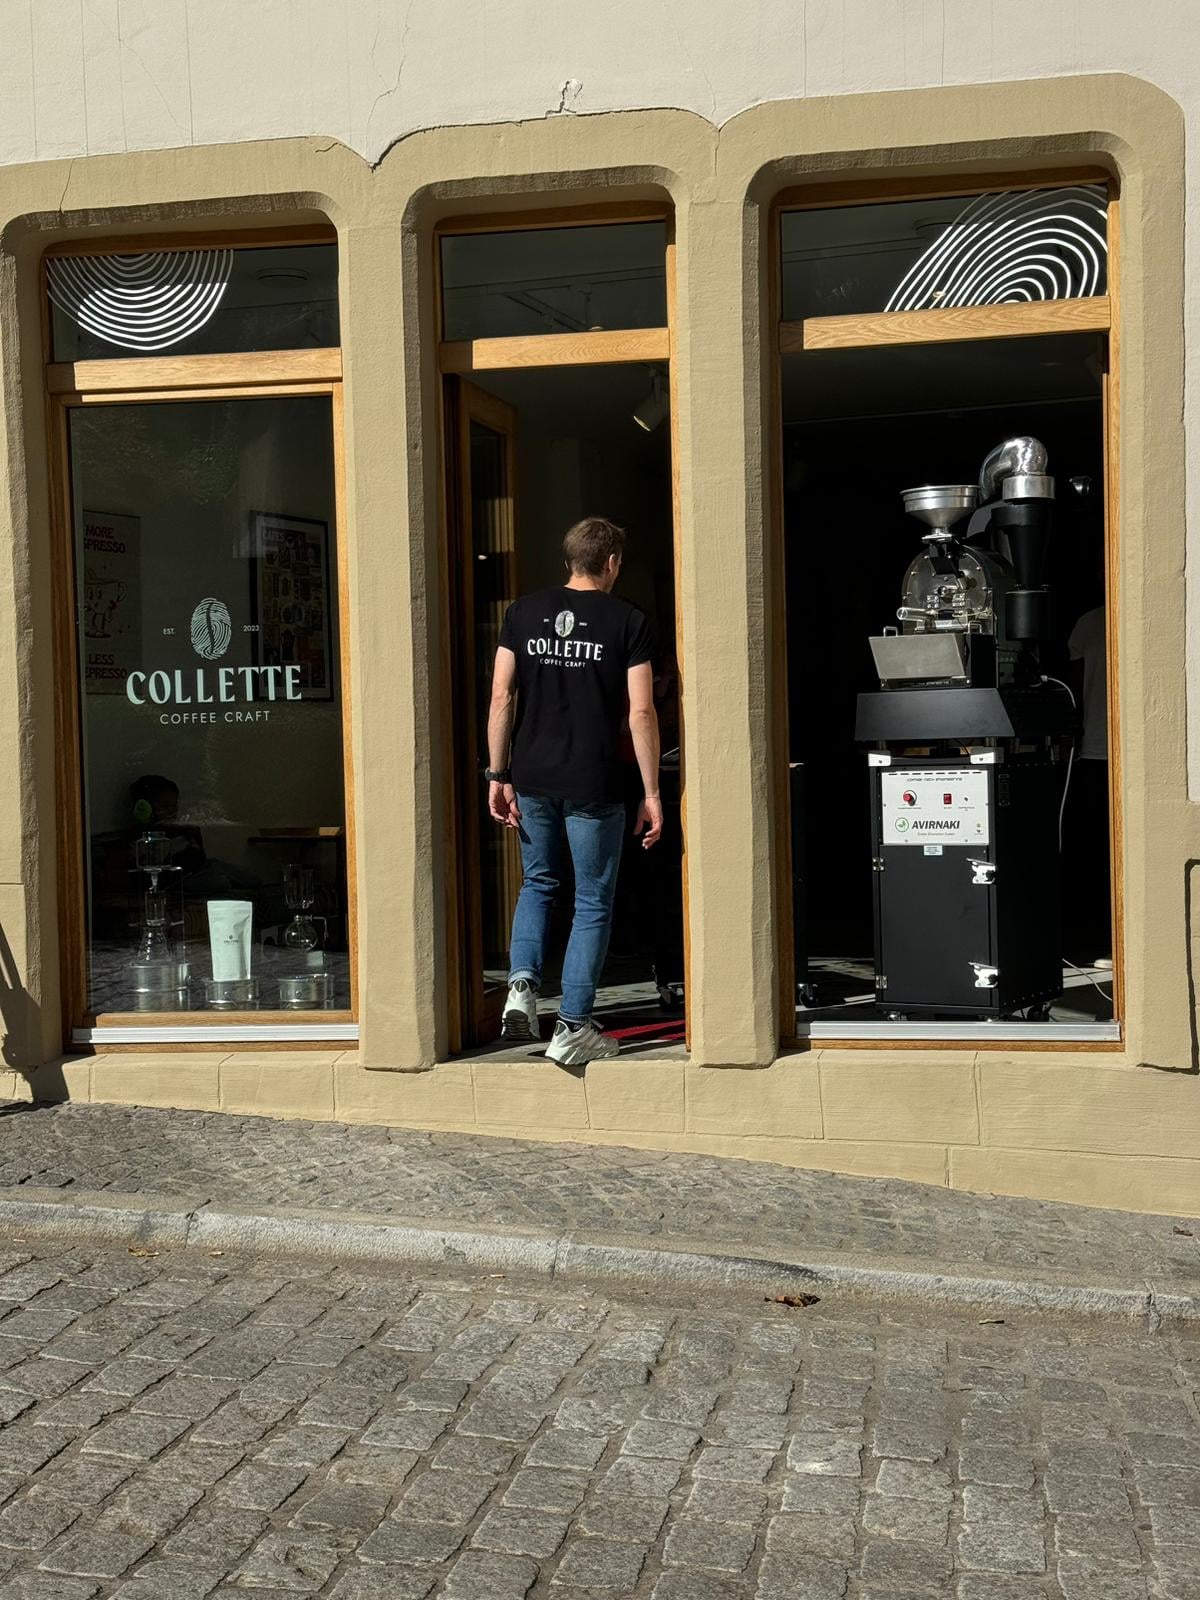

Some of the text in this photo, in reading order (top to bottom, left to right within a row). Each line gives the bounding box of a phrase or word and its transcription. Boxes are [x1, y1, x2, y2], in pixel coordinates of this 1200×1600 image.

[86, 525, 114, 538] MORE
[527, 638, 603, 661] COLLETTE
[89, 653, 114, 665] LESS
[565, 660, 586, 668] CRAFT
[85, 666, 128, 679] EPRESSO
[126, 665, 302, 705] COLLETTE
[159, 710, 270, 725] COFFEE CRAFT
[911, 820, 960, 830] AVIRNAKI
